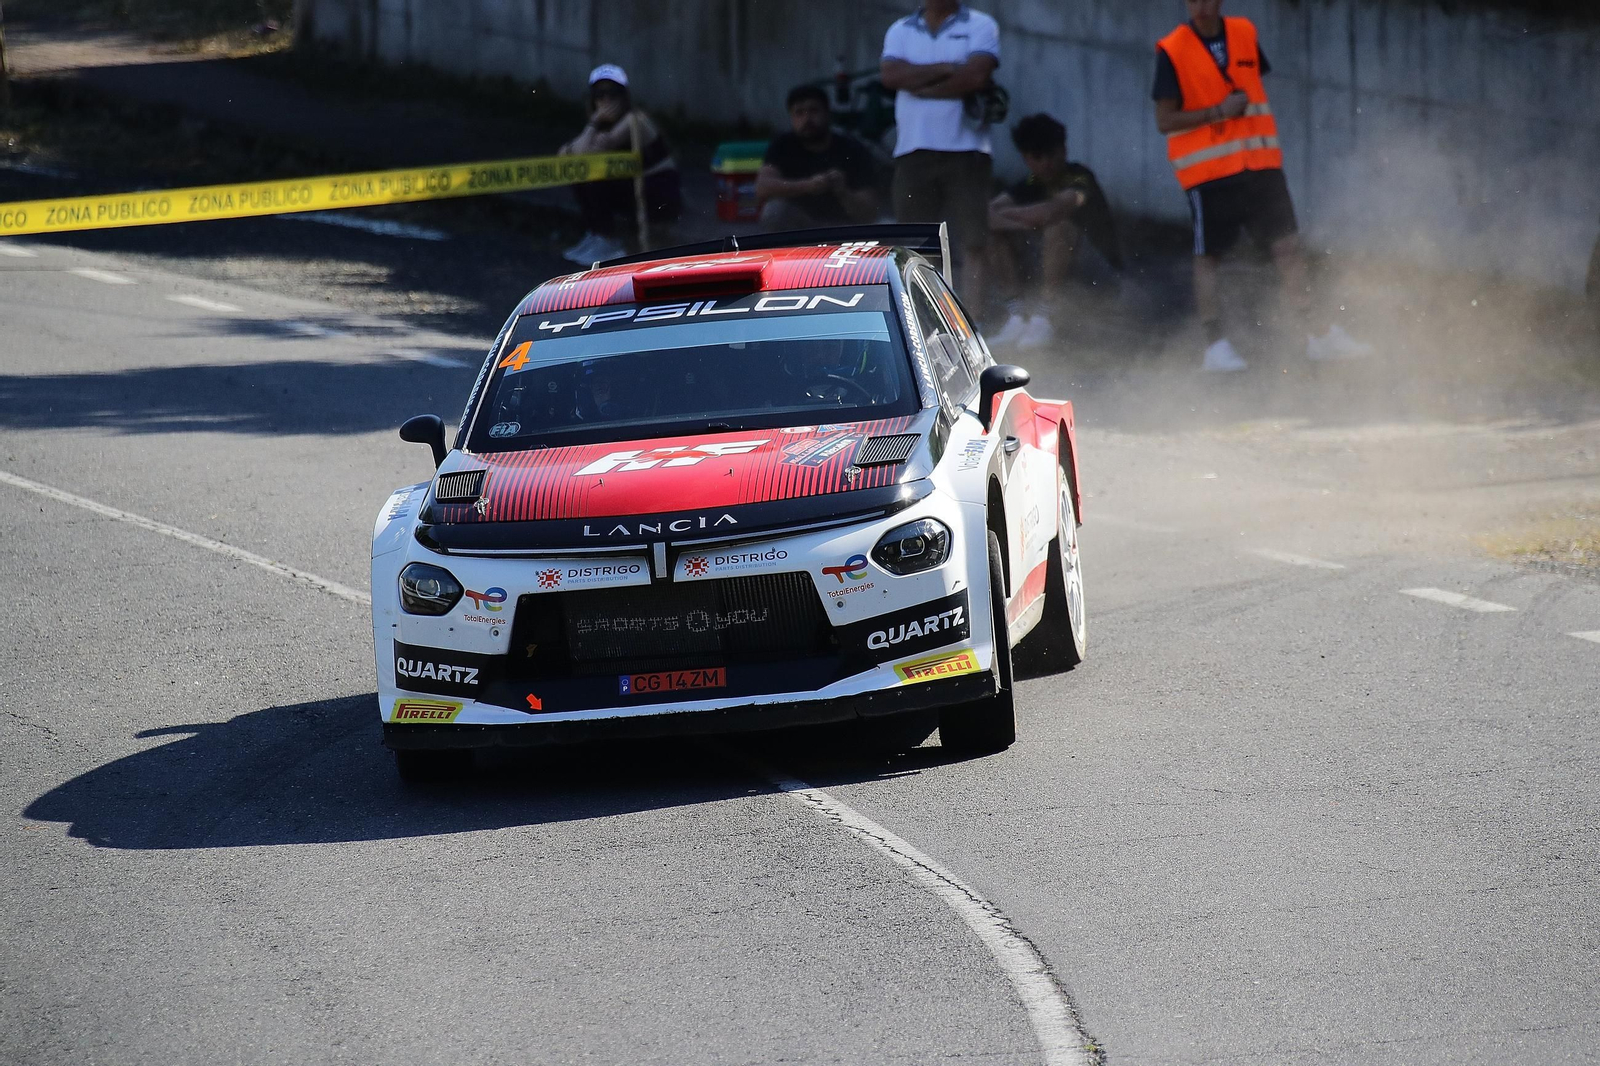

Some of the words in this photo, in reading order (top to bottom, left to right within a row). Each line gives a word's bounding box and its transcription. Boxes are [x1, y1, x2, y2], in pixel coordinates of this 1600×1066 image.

[45, 205, 92, 225] ZONA
[97, 197, 172, 221] PUBLICO
[188, 194, 234, 214] ZONA
[239, 184, 313, 209] PUBLICO
[329, 181, 374, 201] ZONA
[380, 171, 452, 196] PUBLICO
[468, 167, 513, 189] ZONA
[516, 161, 590, 184] PUBLICO
[538, 293, 865, 333] YPSILON
[498, 340, 533, 371] 4
[489, 422, 520, 437] FIA
[583, 514, 738, 537] LANCIA
[714, 550, 789, 566] DISTRIGO
[735, 562, 777, 570] DISTRIBUTION
[567, 564, 641, 579] DISTRIGO
[586, 575, 629, 583] DISTRIBUTION
[827, 581, 875, 598] TotalEnergies
[463, 614, 506, 625] TotalEnergies
[866, 605, 965, 650] QUARTZ
[396, 657, 479, 685] QUARTZ
[901, 654, 973, 680] PIRELLI
[396, 703, 457, 719] PIRELLI
